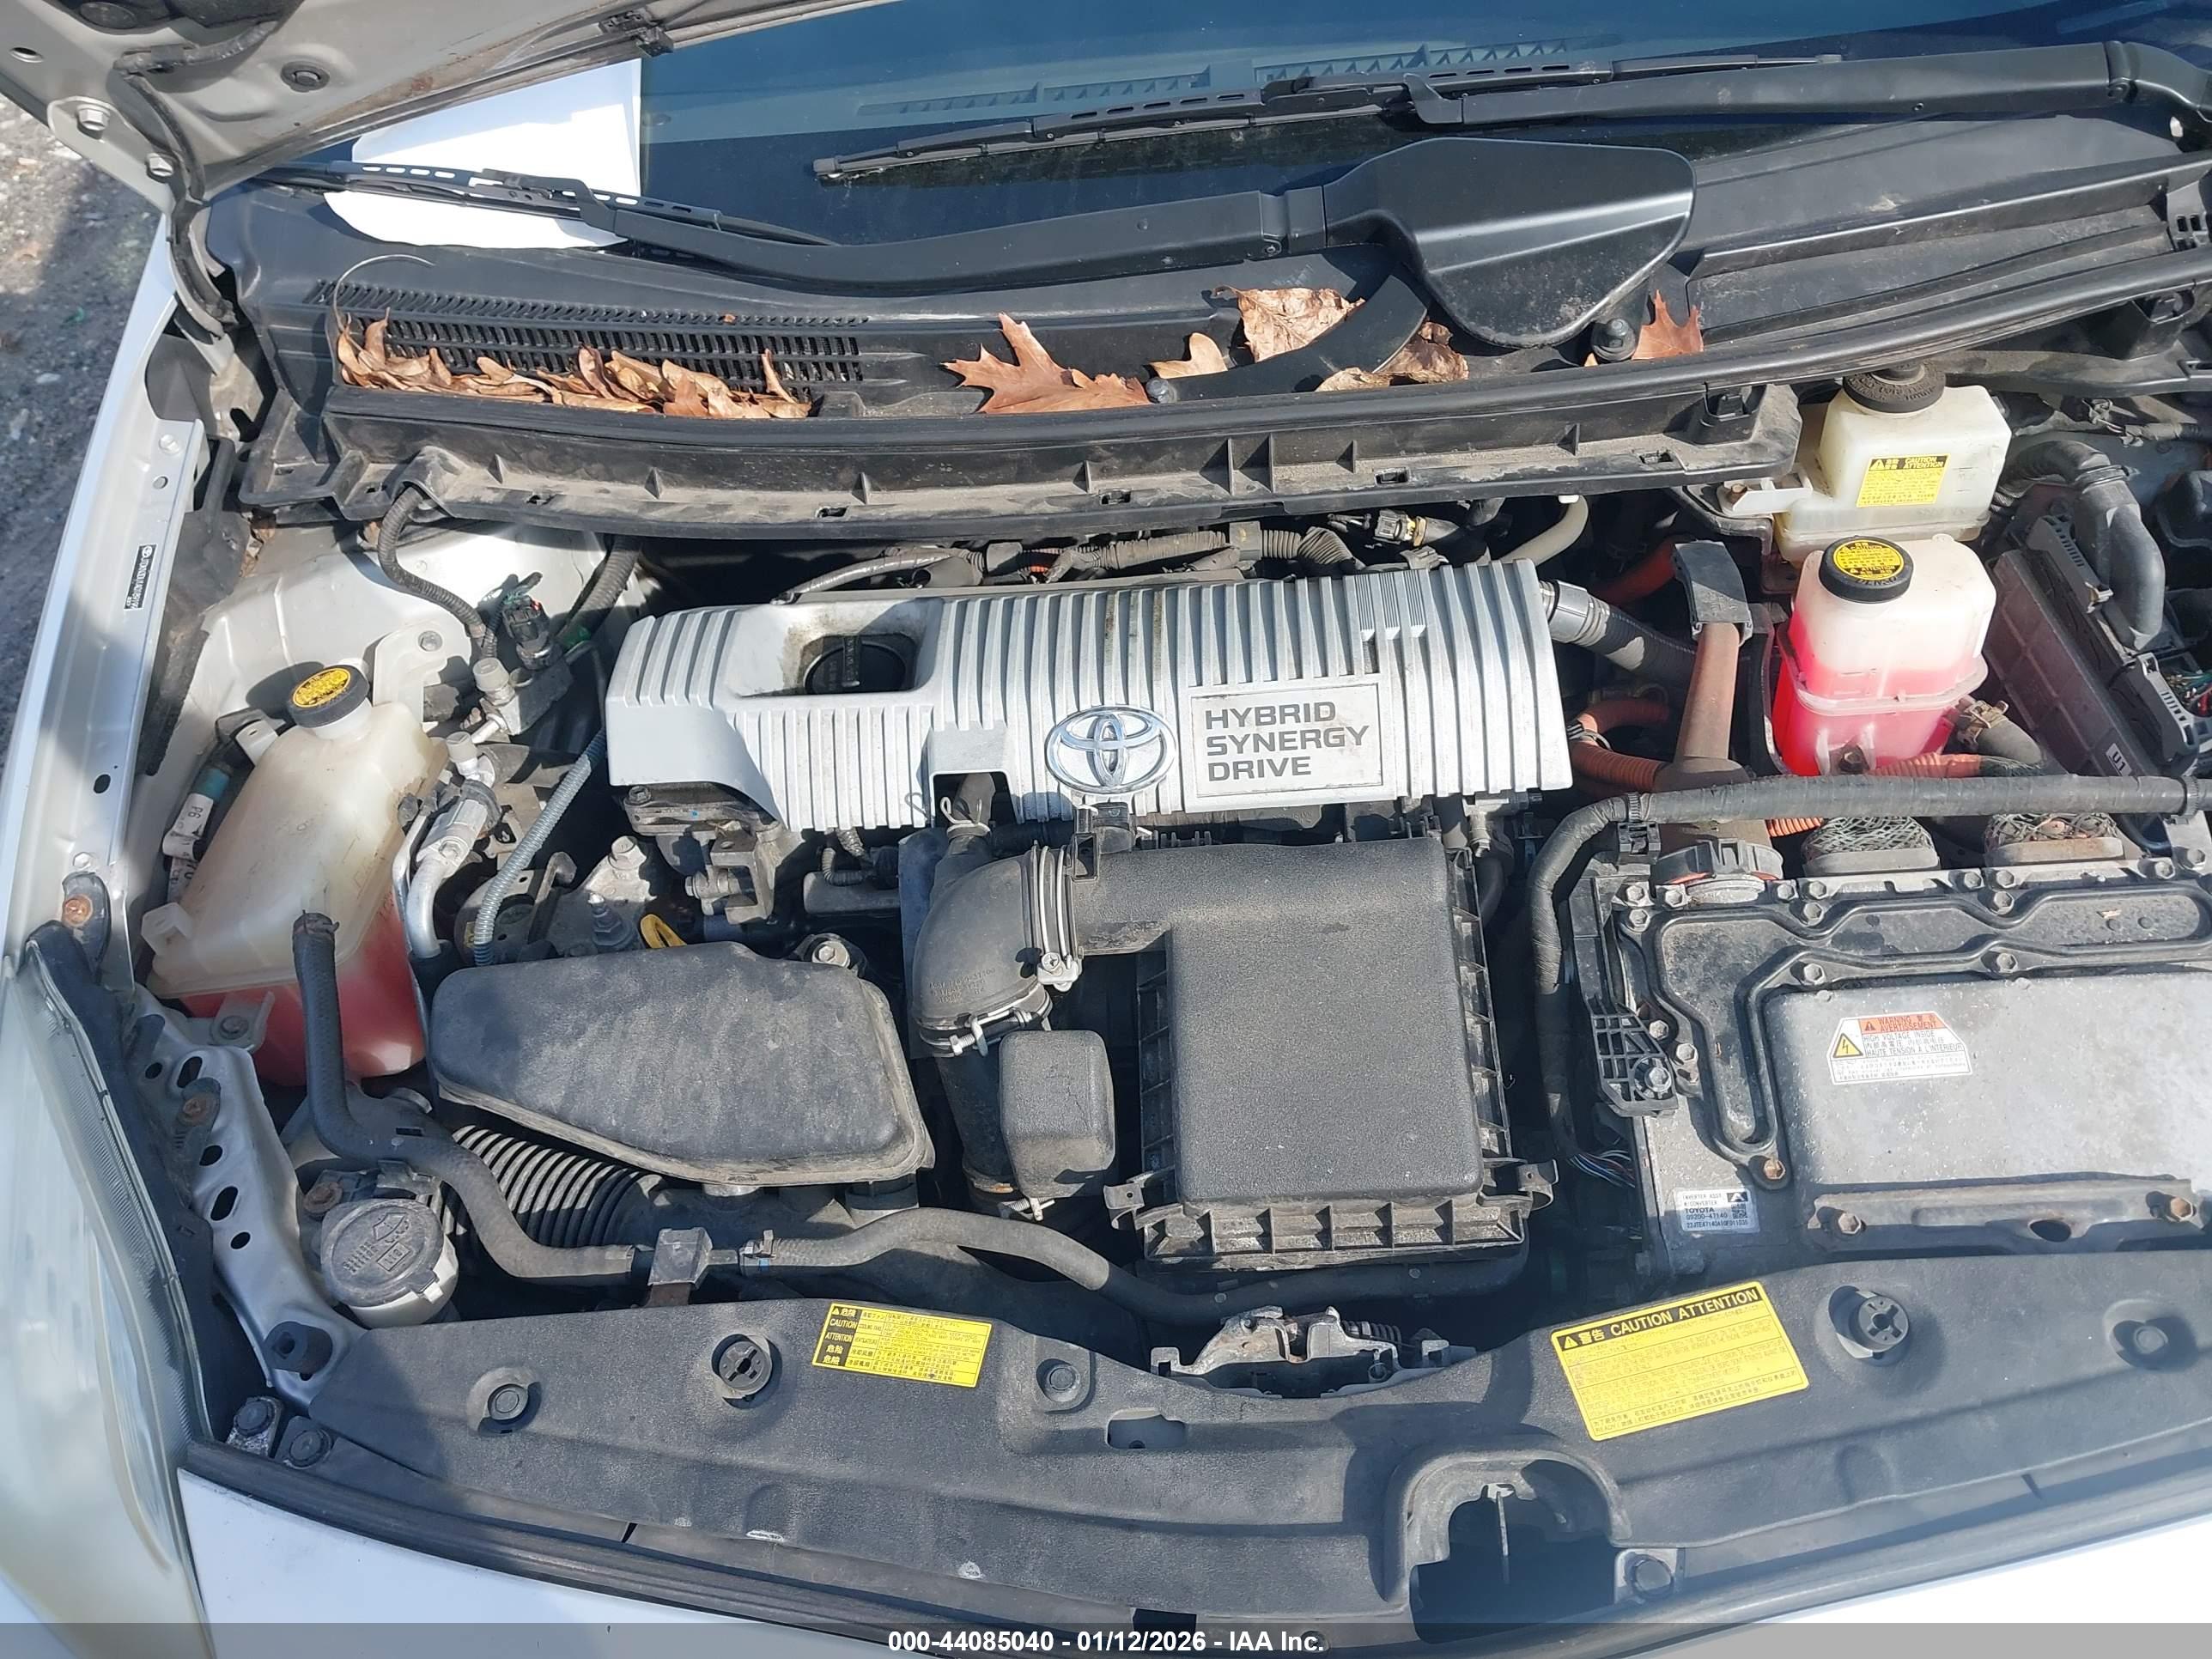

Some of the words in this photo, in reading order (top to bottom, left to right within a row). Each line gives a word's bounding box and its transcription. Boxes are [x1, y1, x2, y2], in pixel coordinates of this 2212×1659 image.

[1206, 702, 1336, 730] HYBRID
[1206, 726, 1370, 757] SYNERGY
[1208, 757, 1311, 781] DRIVE
[1878, 1016, 1911, 1025] WARNING
[1881, 1021, 1937, 1032] AVERTISSEMENT
[1883, 1032, 1911, 1041] VOLTAGE
[1867, 1048, 1887, 1057] HAUTE
[1889, 1046, 1916, 1055] TENSION
[1579, 1328, 1606, 1346] 警告
[1610, 1310, 1673, 1337] CAUTION
[1678, 1289, 1759, 1321] ATTENTION
[830, 1318, 858, 1329] CAUTION
[825, 1332, 853, 1343] ATTENTION
